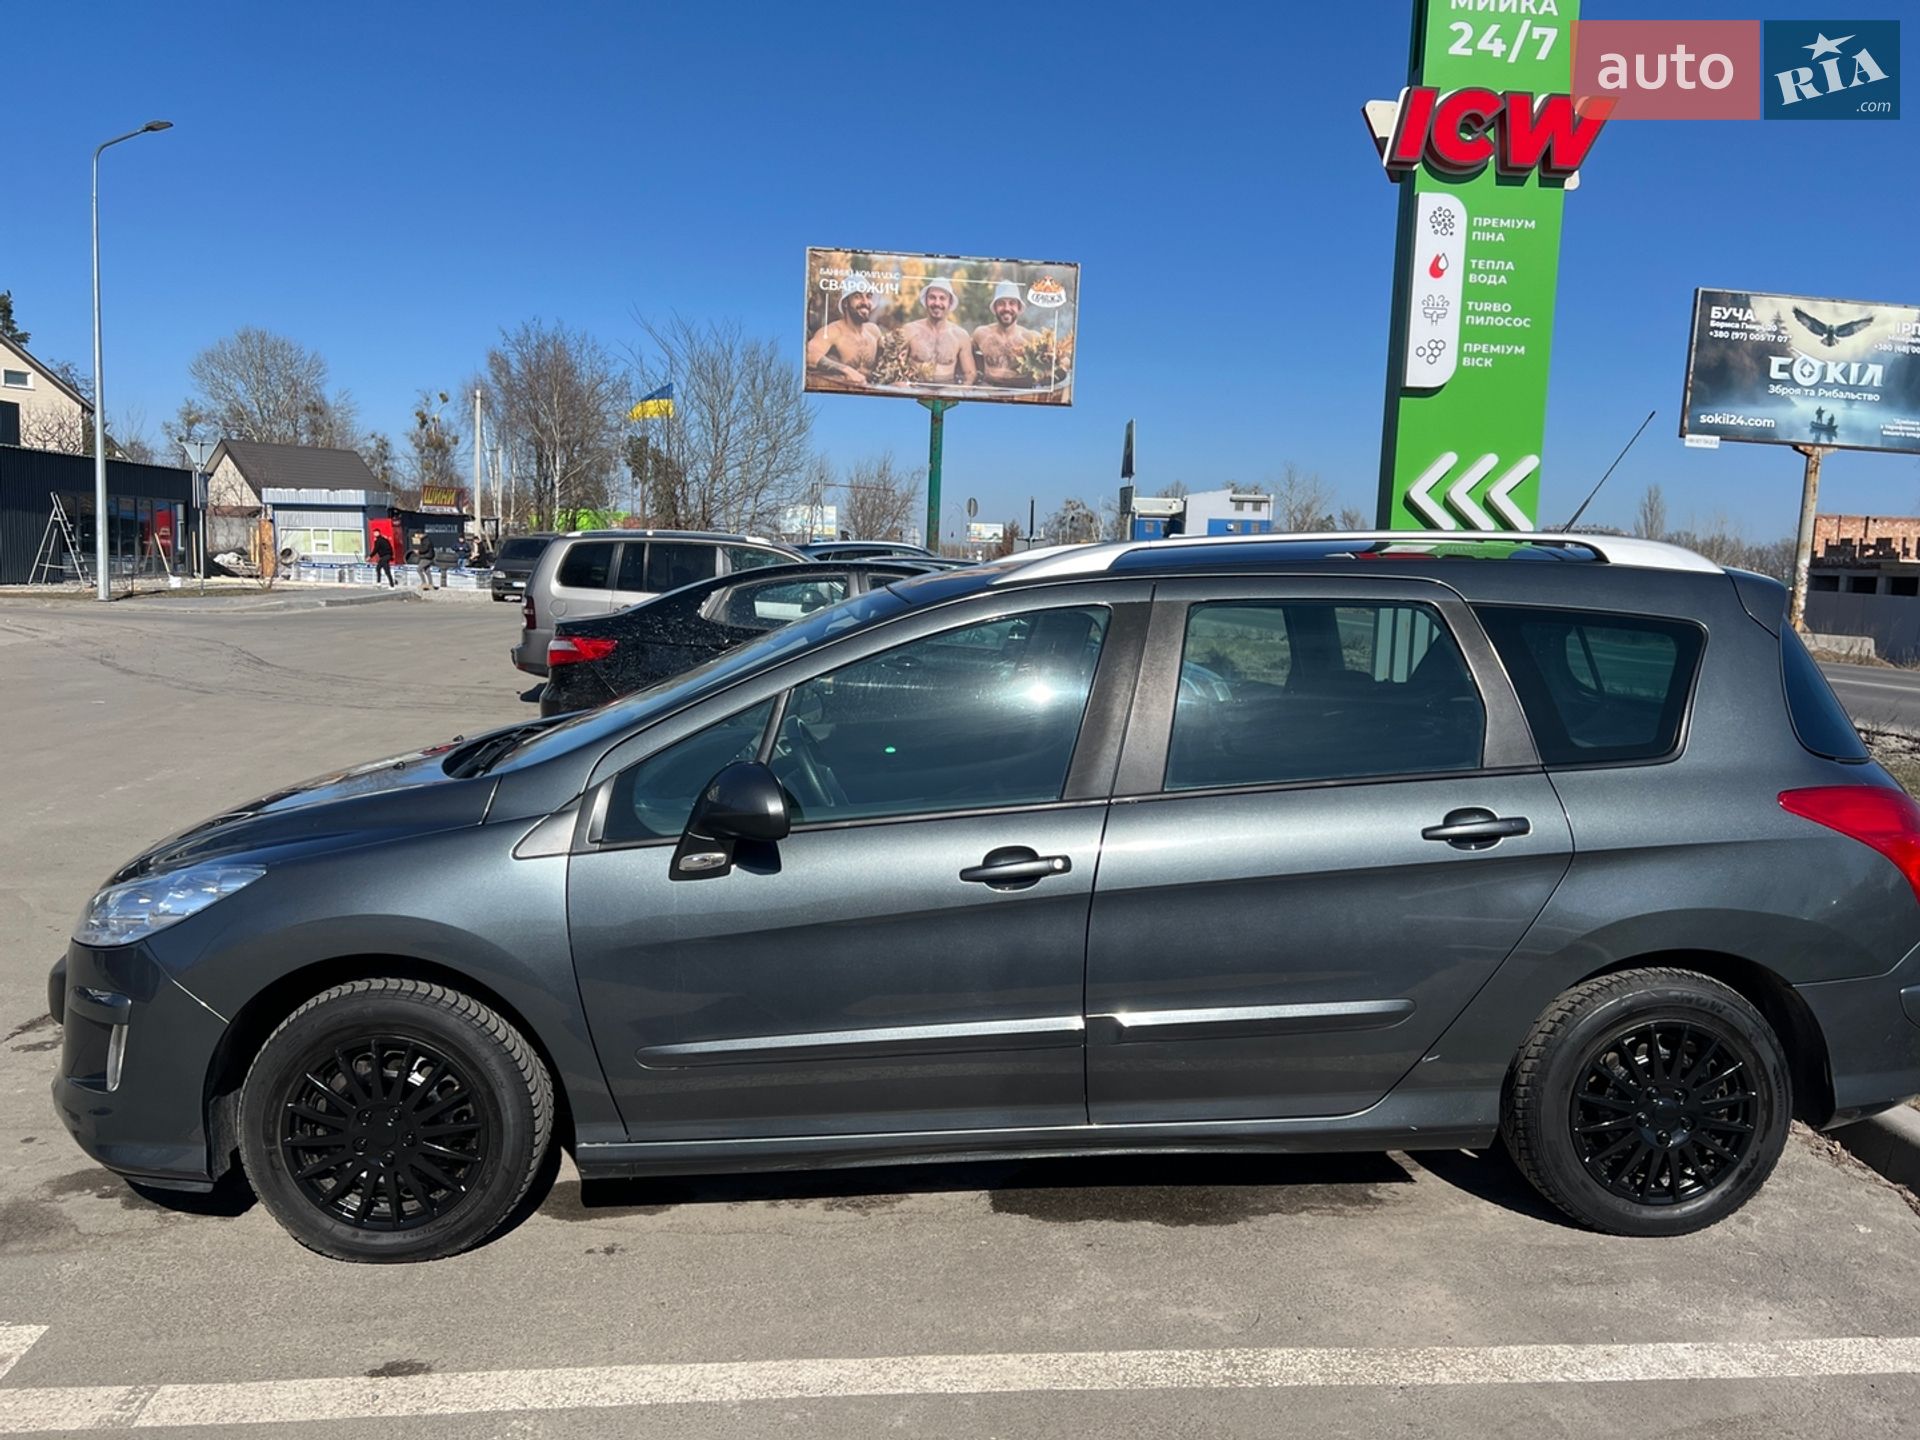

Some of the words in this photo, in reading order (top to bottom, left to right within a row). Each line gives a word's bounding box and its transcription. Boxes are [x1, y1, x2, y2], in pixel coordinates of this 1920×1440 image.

[1448, 19, 1558, 63] 24/7
[1386, 86, 1620, 178] ICW
[1473, 217, 1536, 229] ПРЕМІУМ
[1472, 231, 1505, 242] ПІНА
[1470, 259, 1514, 271] ТЕПЛА
[1469, 273, 1507, 285] ВОДА
[819, 278, 899, 294] СВАРОЖИЧ
[1467, 301, 1512, 313] TURBO
[1711, 306, 1755, 321] БУЧА
[1466, 315, 1531, 328] ПИЛОСОС
[1463, 343, 1525, 355] ПРЕМІУМ
[1462, 357, 1493, 368] ВІСК
[1768, 350, 1883, 387] СОКІЛ
[1768, 384, 1801, 396] Зброя
[1804, 388, 1815, 396] та
[1818, 388, 1880, 401] Рибальство
[1699, 413, 1775, 428] sokil24.com
